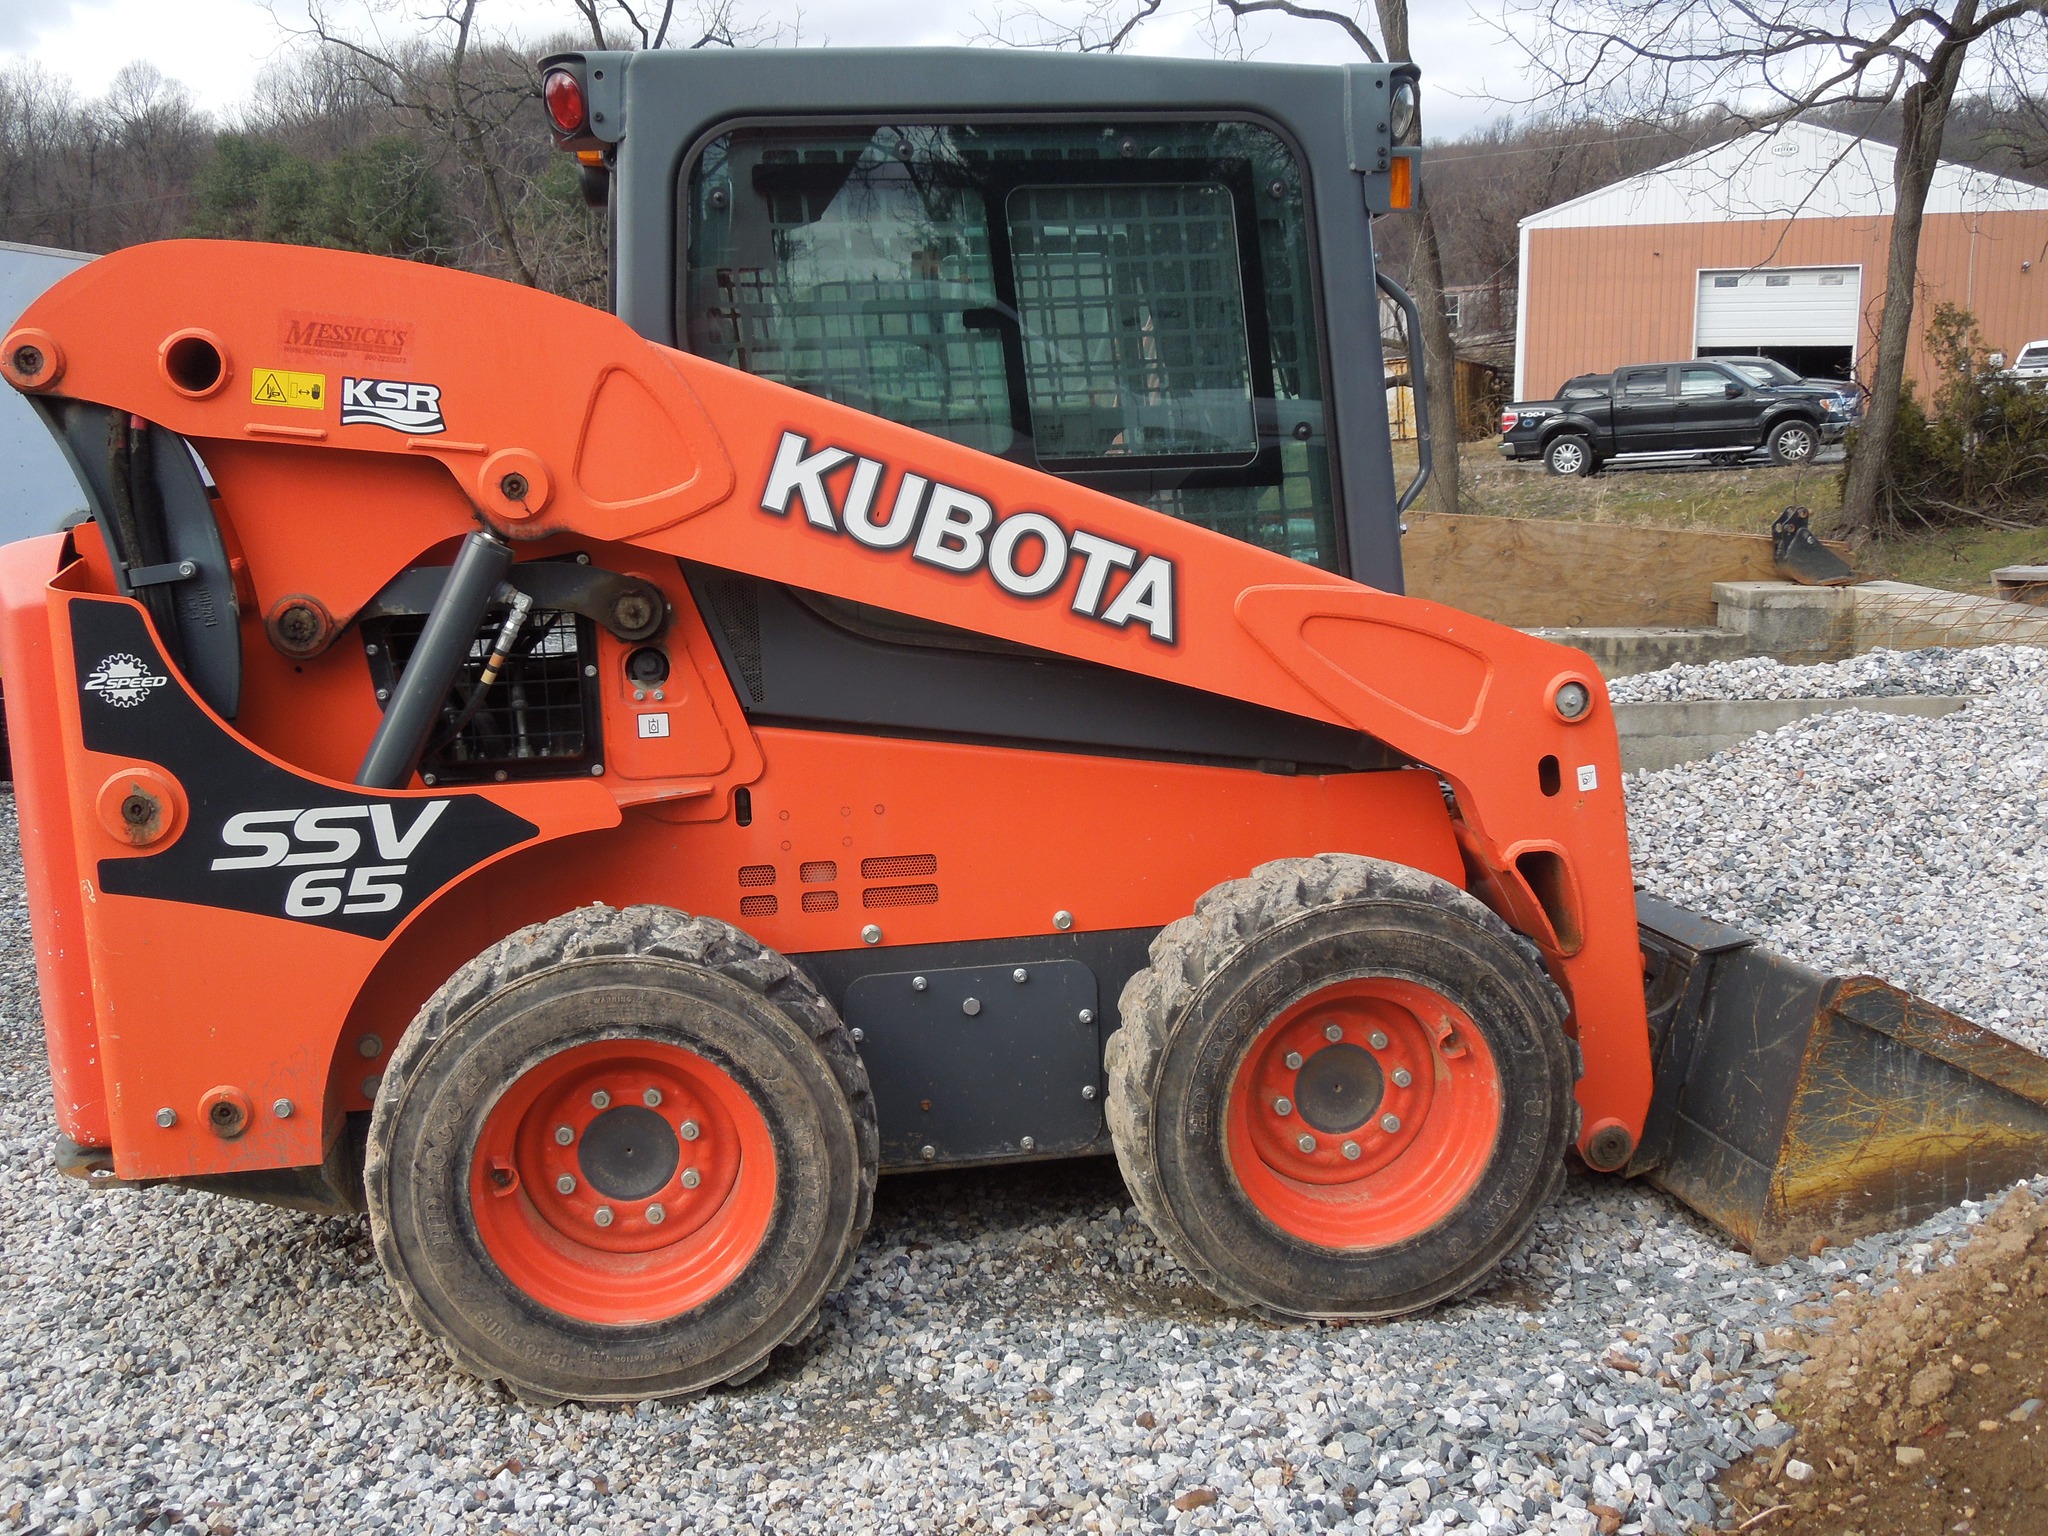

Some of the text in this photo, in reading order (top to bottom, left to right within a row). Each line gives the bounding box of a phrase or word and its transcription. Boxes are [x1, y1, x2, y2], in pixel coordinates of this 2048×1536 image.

[284, 320, 407, 346] MESSICK'S
[343, 378, 440, 412] KSR
[760, 431, 1177, 643] KUBOTA
[210, 799, 451, 870] SSV
[285, 864, 408, 917] 65
